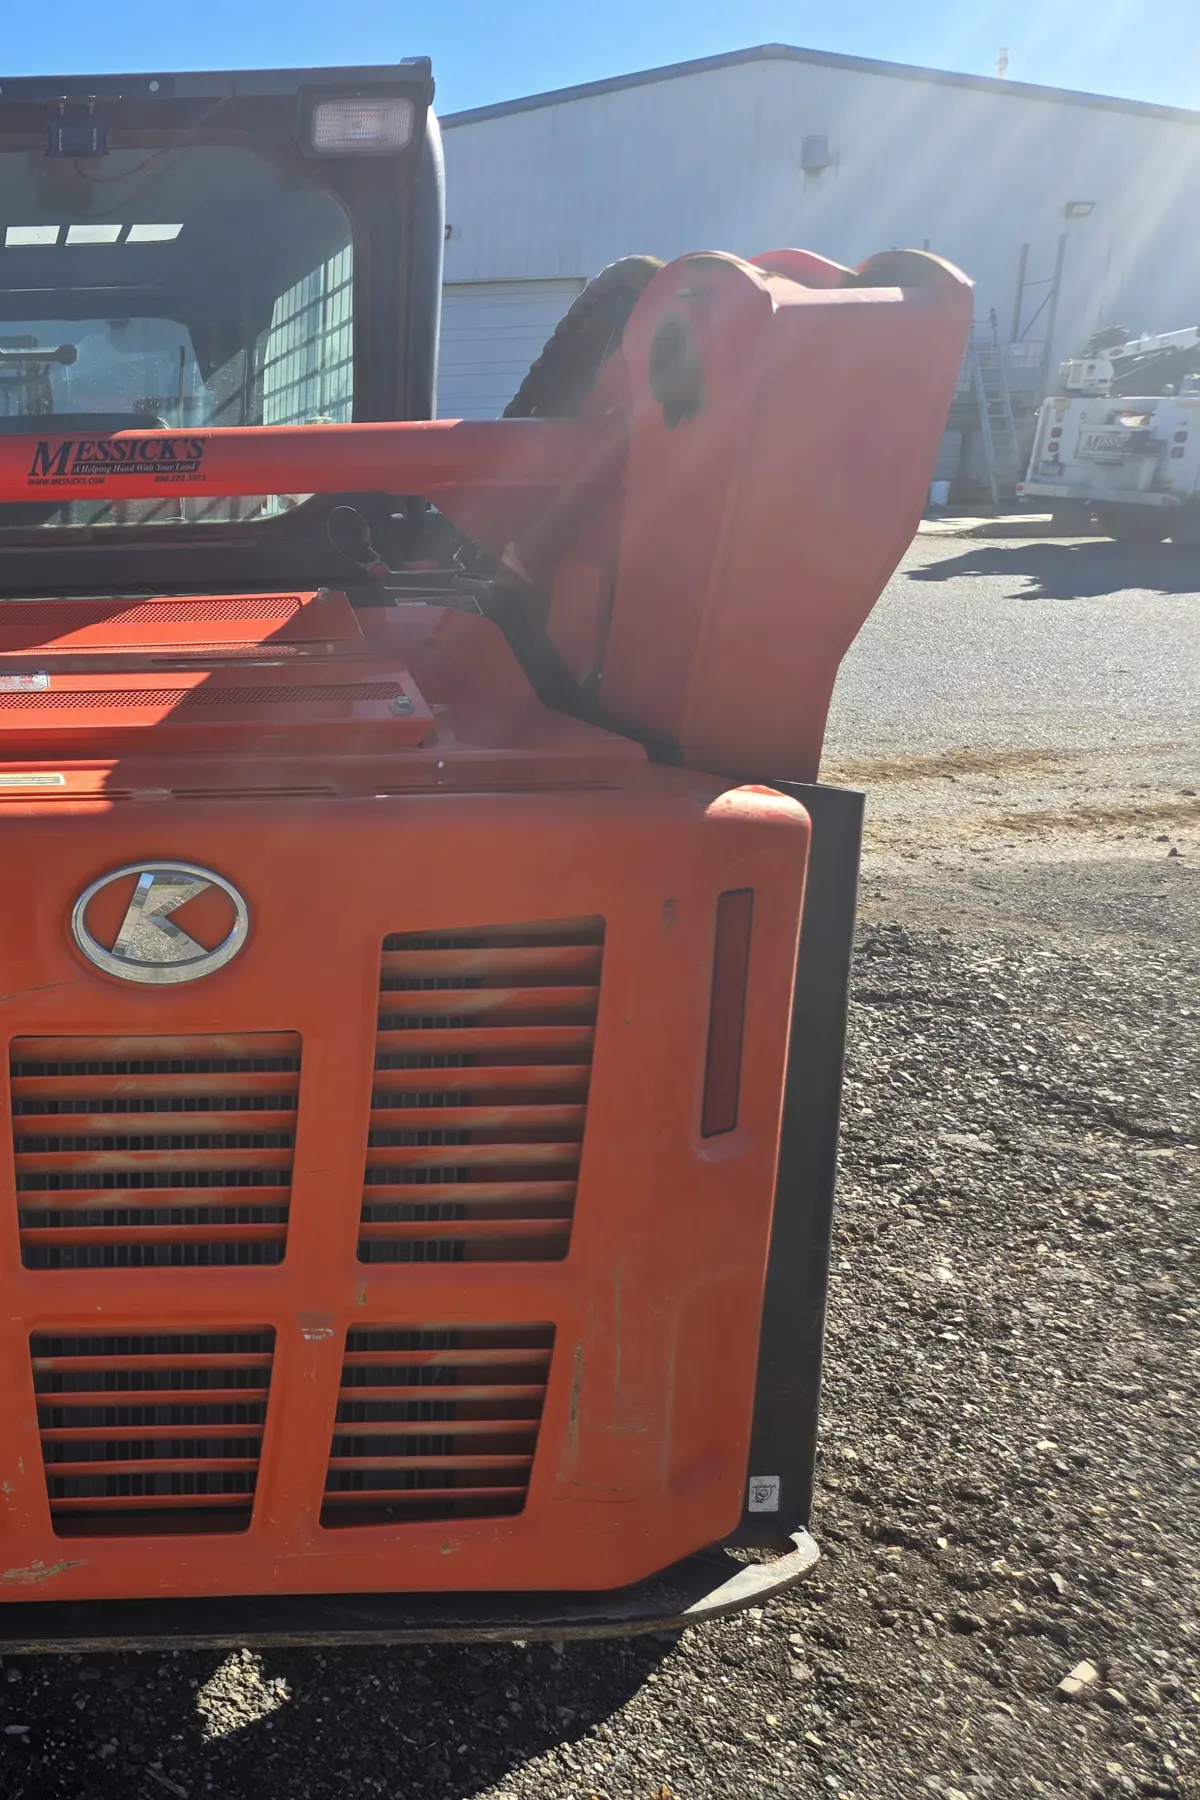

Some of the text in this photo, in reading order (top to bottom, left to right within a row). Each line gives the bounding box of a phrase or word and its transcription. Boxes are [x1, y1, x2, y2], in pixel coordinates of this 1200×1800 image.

[28, 437, 206, 476] MESSICK'S
[73, 462, 196, 475] A Helping Hand With Your Land
